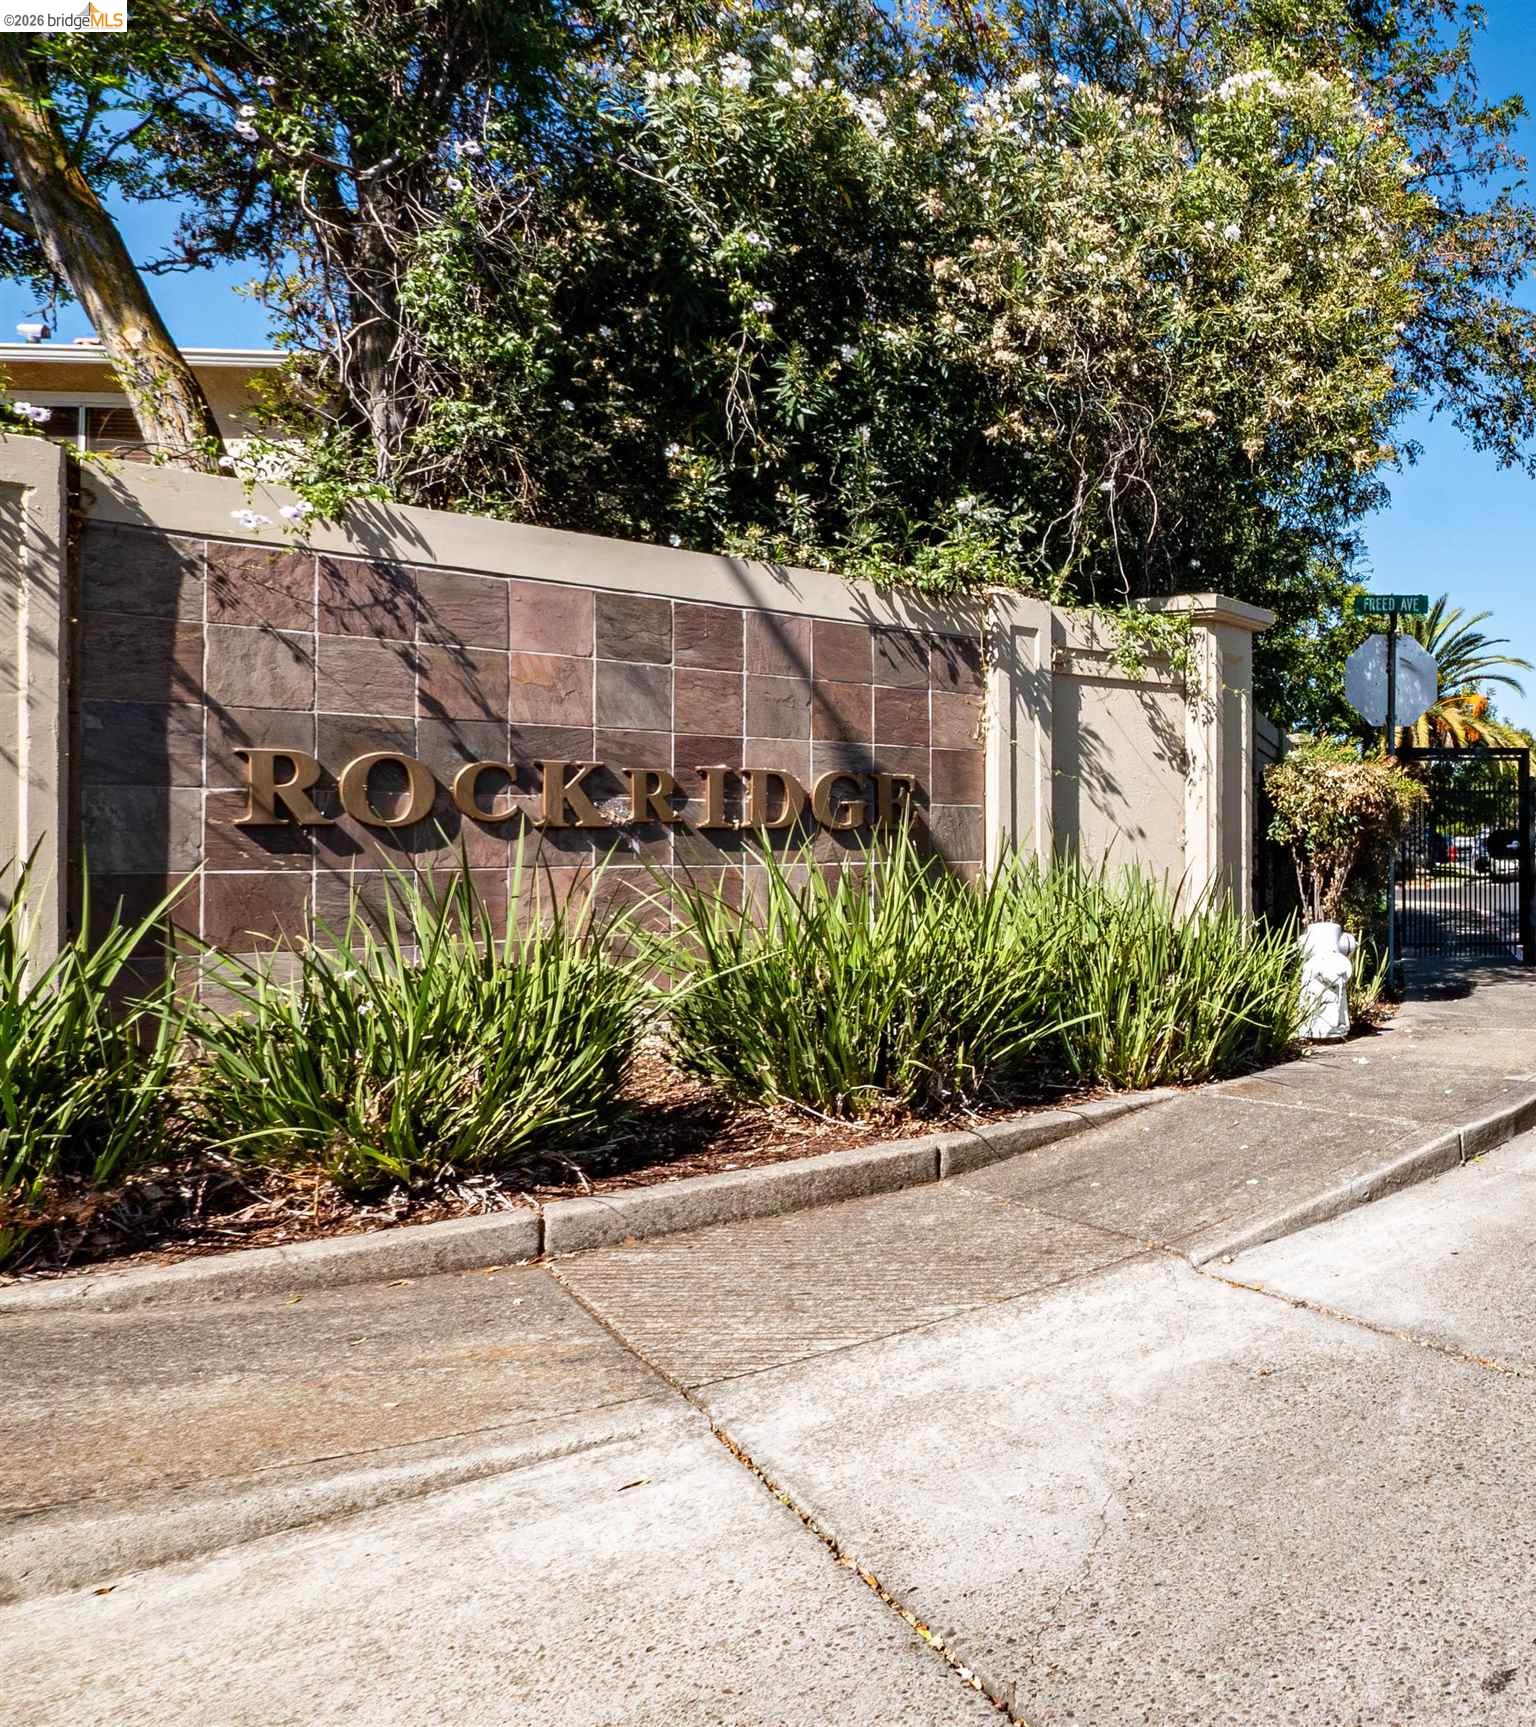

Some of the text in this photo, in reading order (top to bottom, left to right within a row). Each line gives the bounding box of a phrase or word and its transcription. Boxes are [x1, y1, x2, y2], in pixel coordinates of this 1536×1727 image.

[1363, 598, 1419, 611] FREED AVE
[233, 747, 919, 829] ROCKRIDGE
